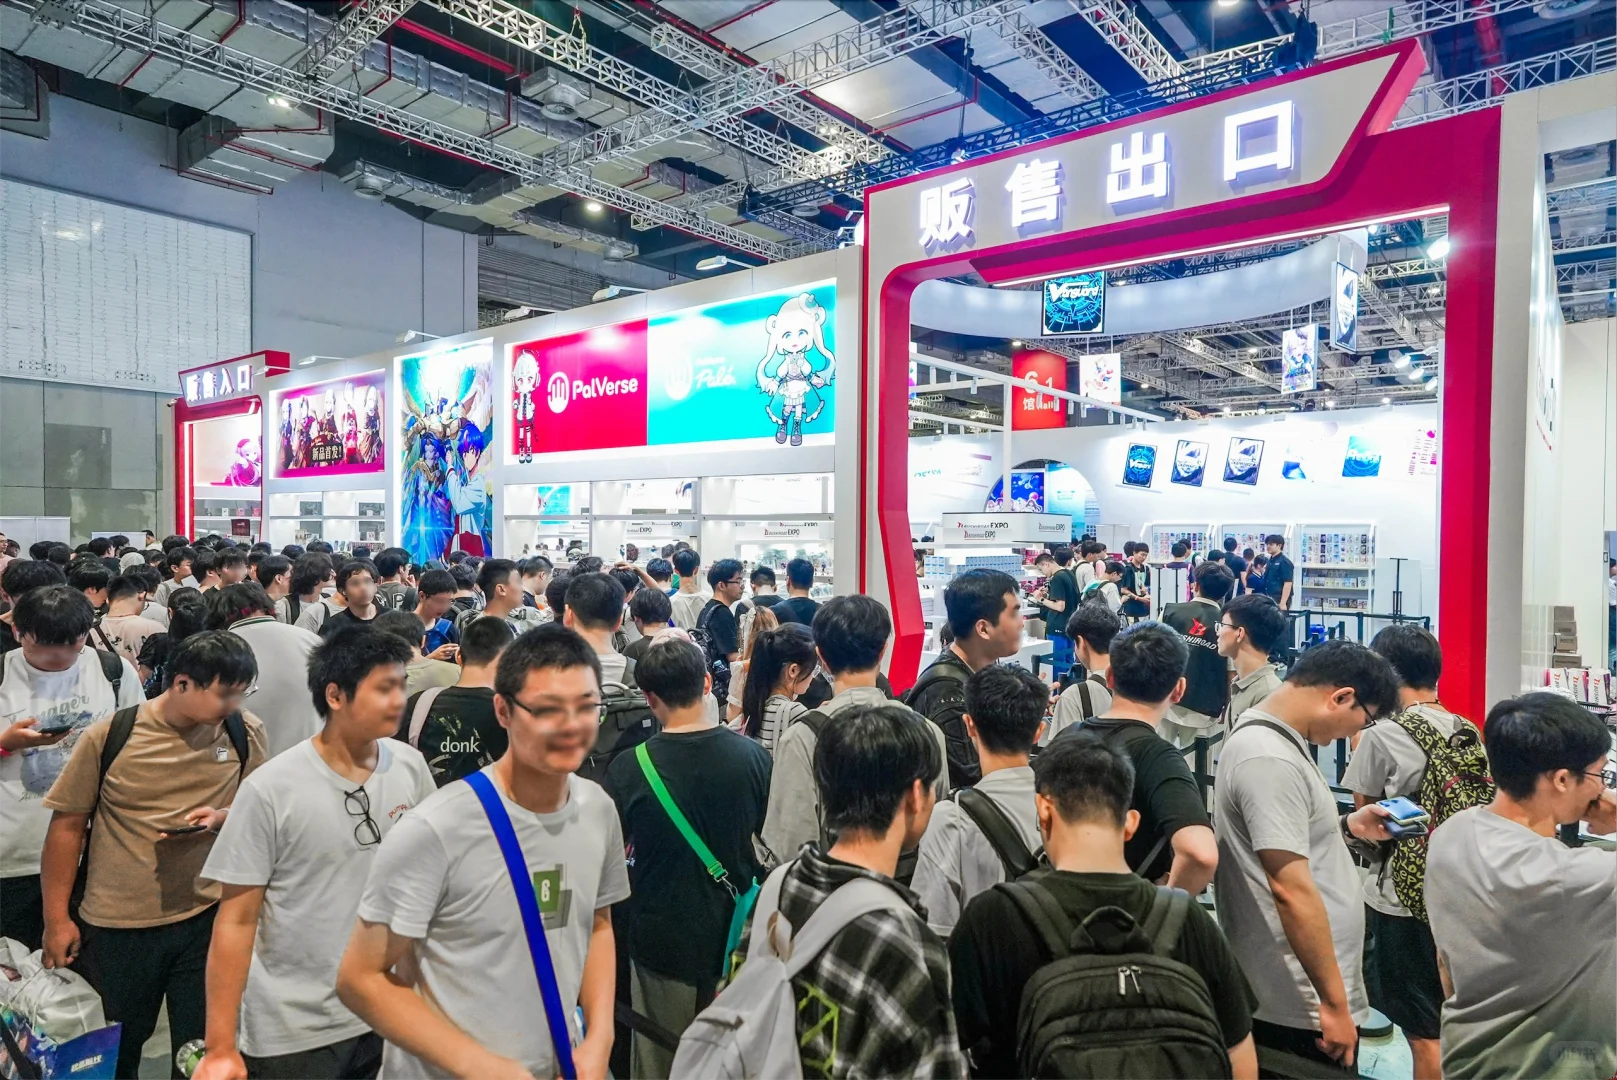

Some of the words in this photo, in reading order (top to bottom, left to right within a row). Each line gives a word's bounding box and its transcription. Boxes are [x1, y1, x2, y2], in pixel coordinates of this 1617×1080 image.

[917, 100, 1297, 249] 贩售出口
[1049, 281, 1100, 302] Vanguard
[572, 376, 639, 400] PalVerse
[1181, 634, 1217, 650] SHIROAD
[440, 736, 480, 753] donk
